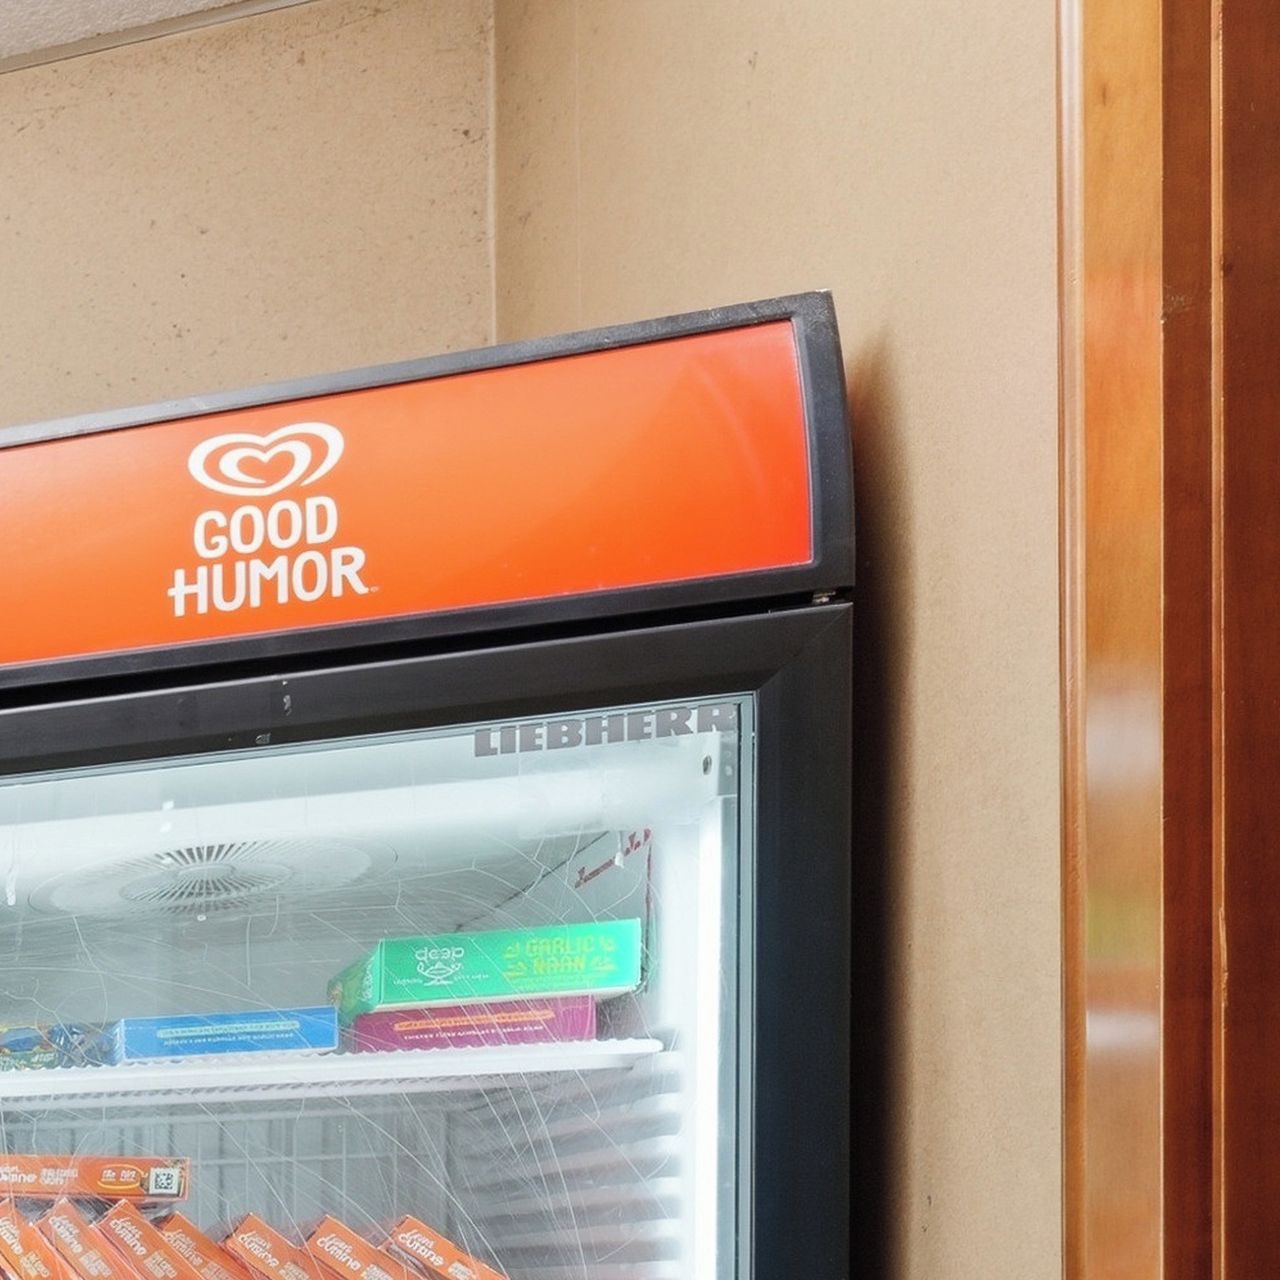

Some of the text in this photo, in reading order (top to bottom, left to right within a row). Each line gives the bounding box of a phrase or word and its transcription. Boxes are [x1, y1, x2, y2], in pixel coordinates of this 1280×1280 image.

[194, 496, 338, 558] GOOD
[168, 546, 370, 617] HUMOR
[474, 703, 736, 757] LIEBHERR
[415, 946, 464, 962] deep
[526, 935, 597, 956] GARLIC
[533, 954, 585, 975] NAAN
